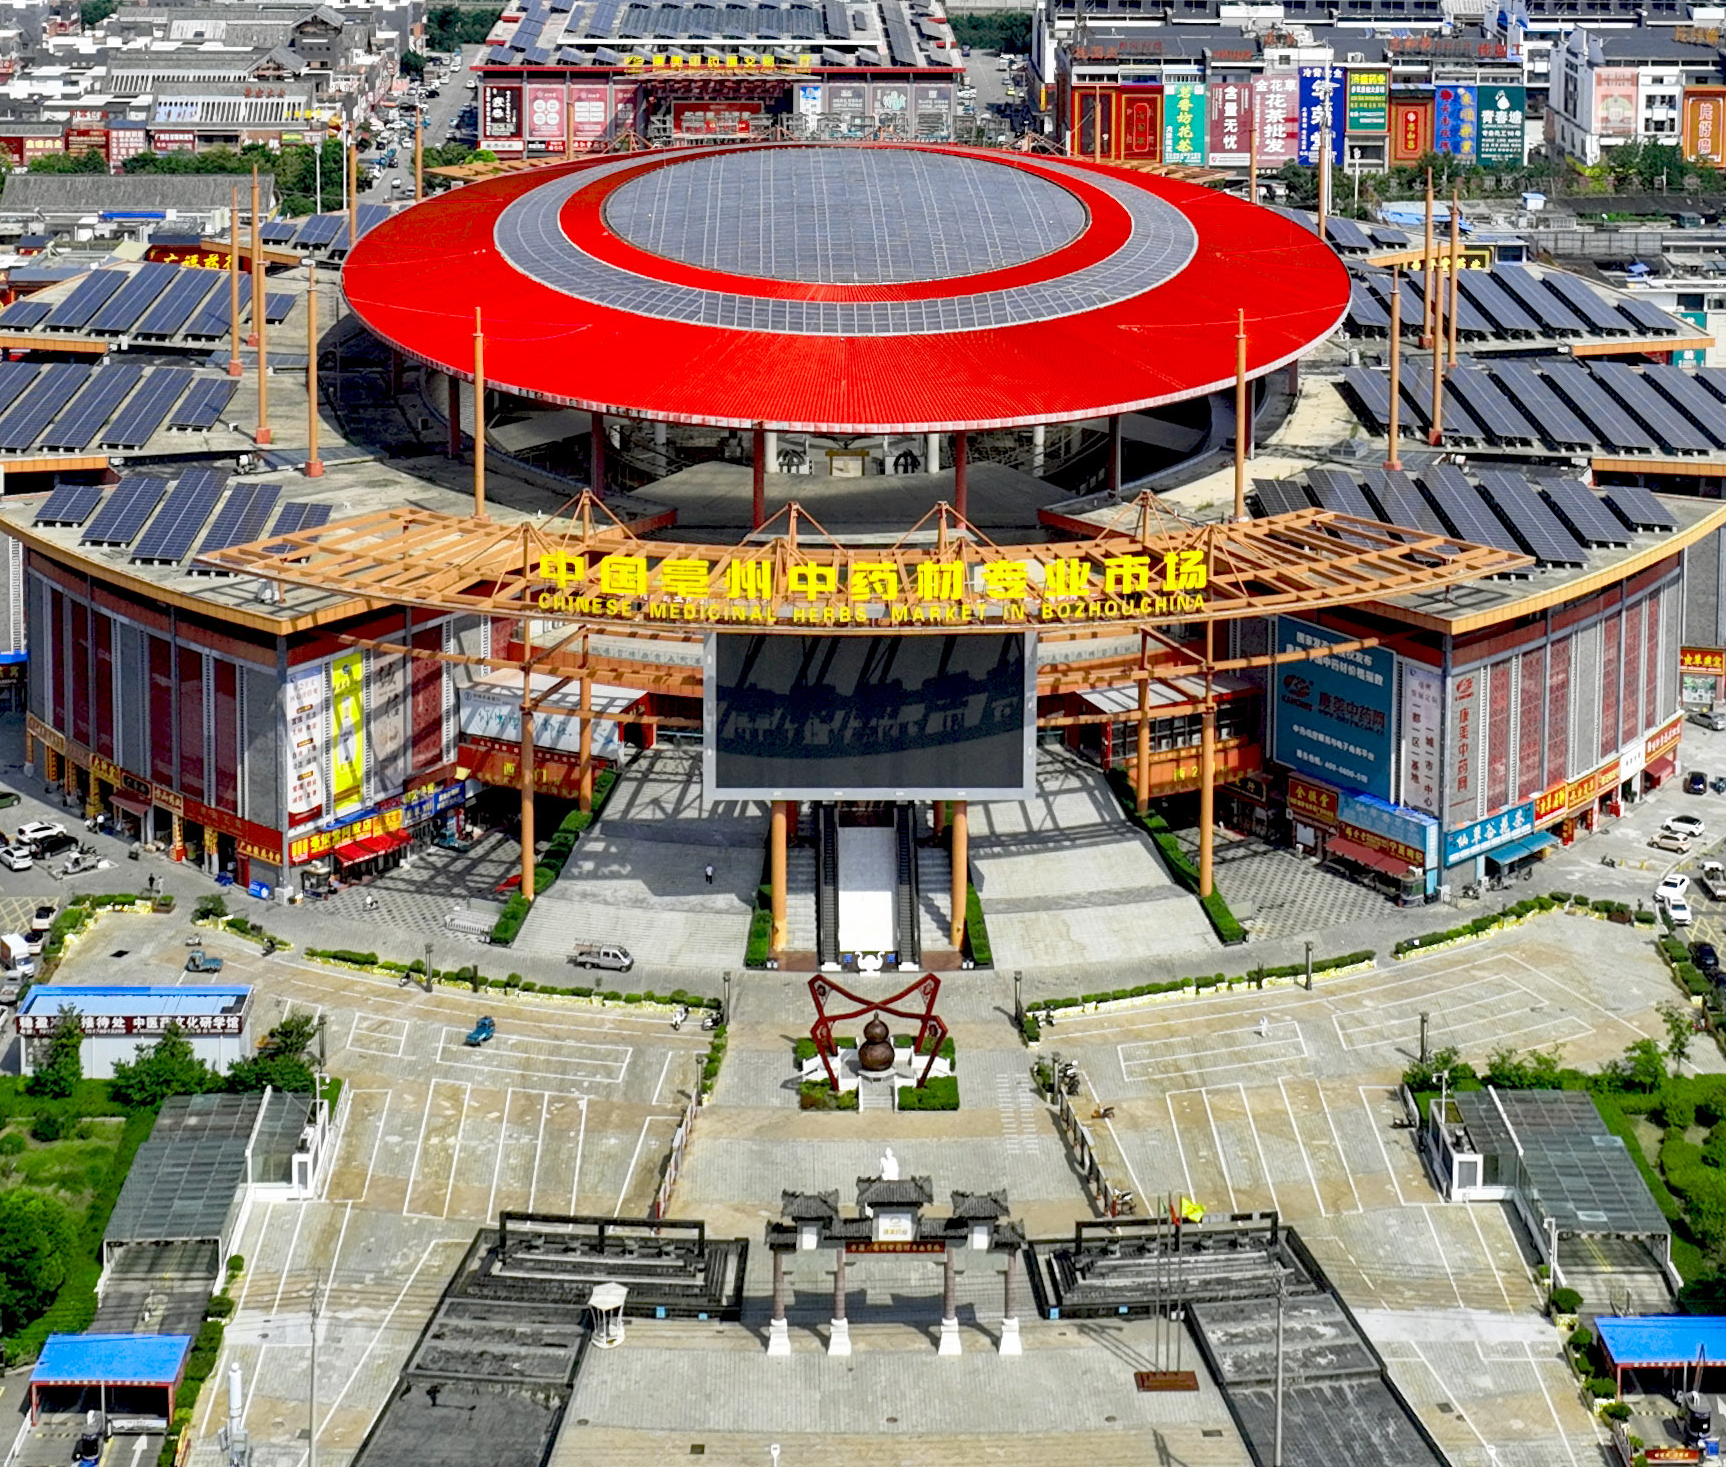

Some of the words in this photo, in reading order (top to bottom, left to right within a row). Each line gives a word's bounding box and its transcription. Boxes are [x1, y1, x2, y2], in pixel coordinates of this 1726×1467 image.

[1223, 84, 1239, 150] 含量无忧
[1264, 93, 1287, 154] 花茶批发
[540, 550, 1208, 602] 中国亳州中药材专业市场
[538, 593, 634, 617] CHINESE
[649, 601, 777, 623] MEDICINAL
[793, 605, 866, 623] HERBS
[891, 603, 987, 622] MARKET
[1002, 602, 1025, 621] IN
[1458, 706, 1471, 793] 康美中药网
